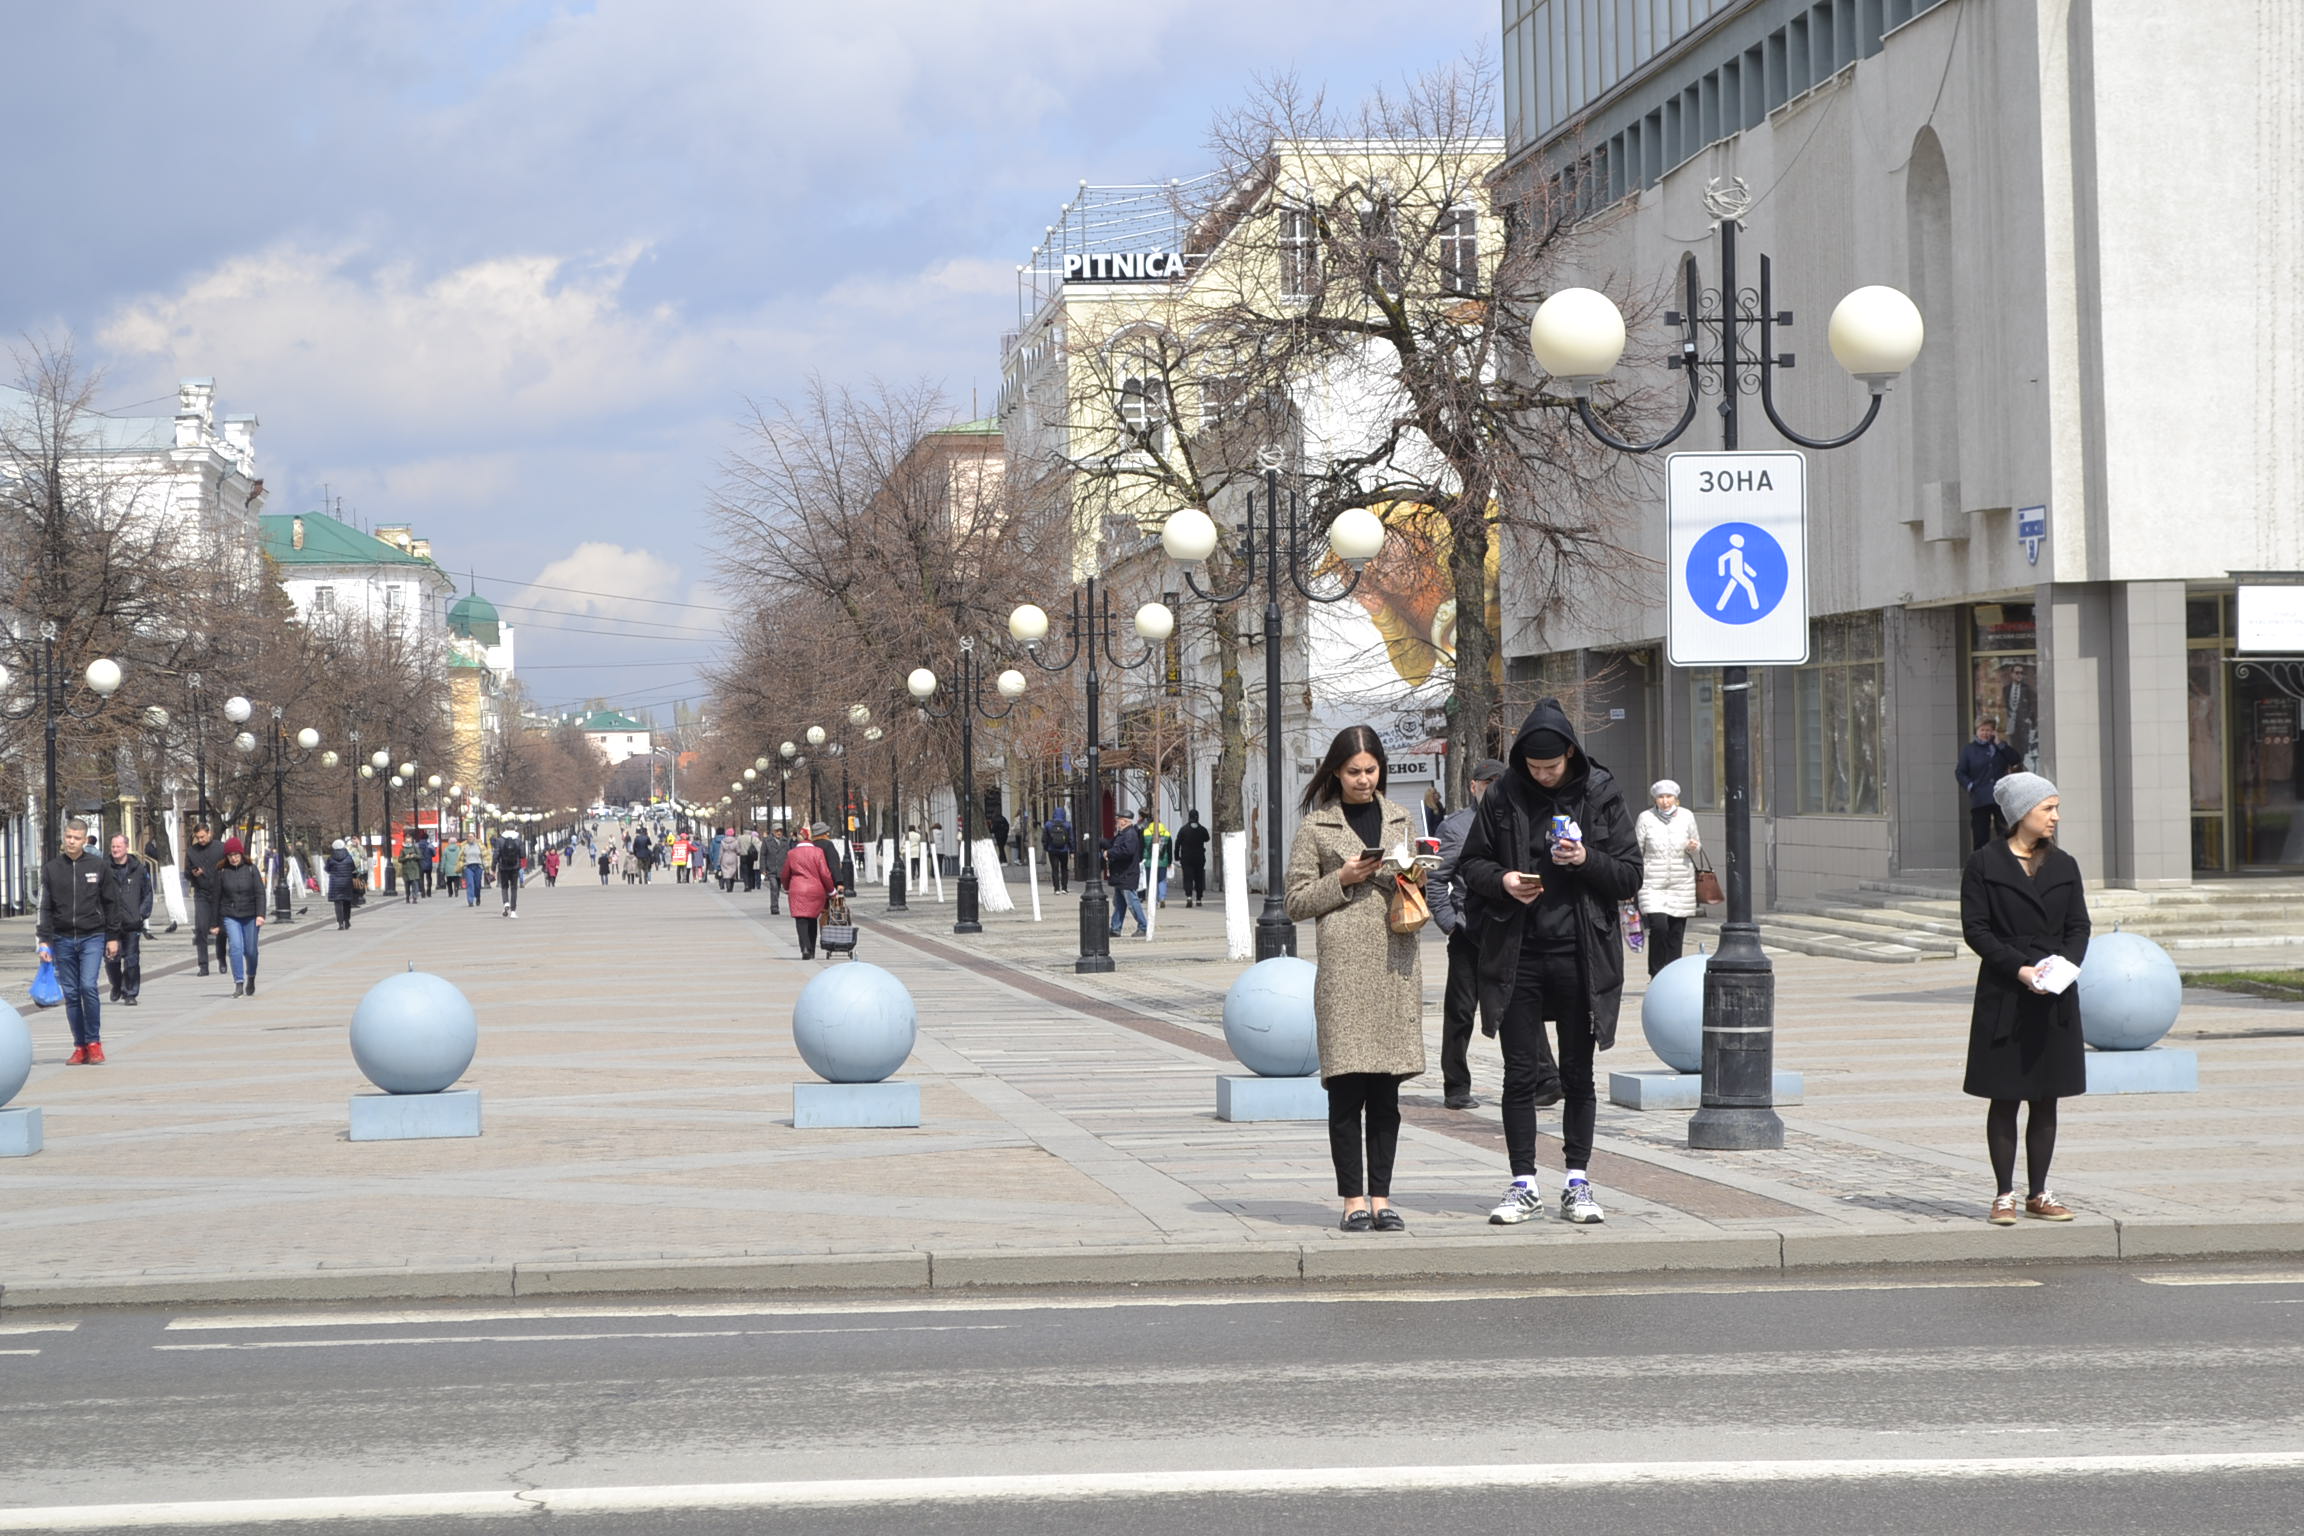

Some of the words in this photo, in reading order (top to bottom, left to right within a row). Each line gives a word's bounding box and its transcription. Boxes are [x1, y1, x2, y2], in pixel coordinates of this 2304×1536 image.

[1063, 247, 1185, 279] PITNIČA
[1699, 470, 1774, 493] ЗОНА
[1388, 762, 1428, 774] ЕНОЕ
